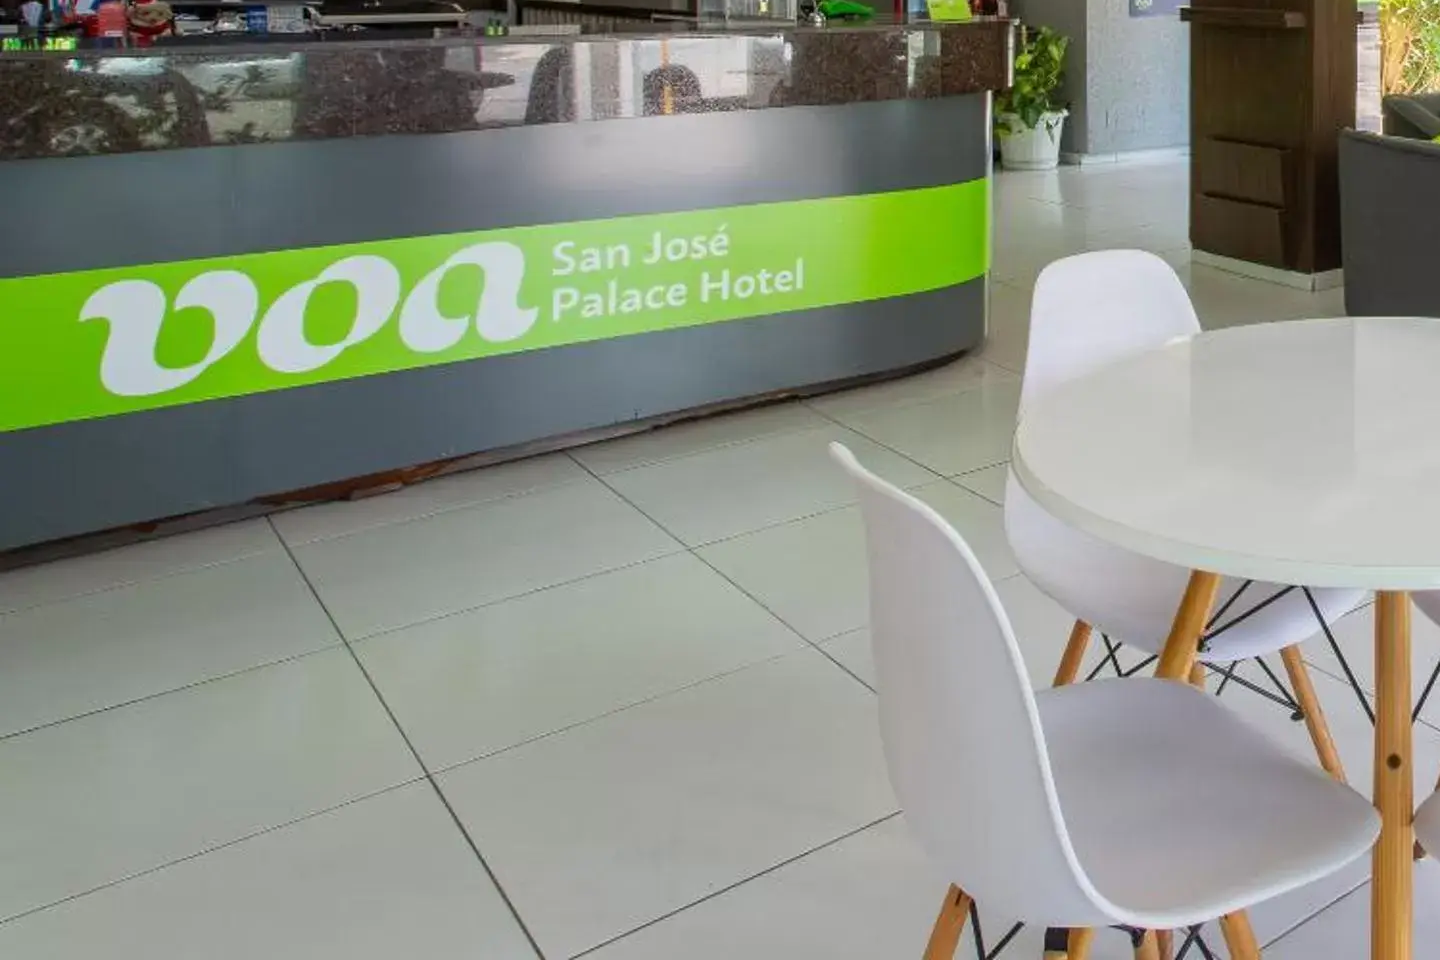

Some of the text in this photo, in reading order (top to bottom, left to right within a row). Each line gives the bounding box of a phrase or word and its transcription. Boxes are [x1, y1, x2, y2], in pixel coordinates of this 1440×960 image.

[552, 223, 730, 276] San José
[78, 241, 539, 396] voa
[552, 257, 805, 322] Palace Hotel
